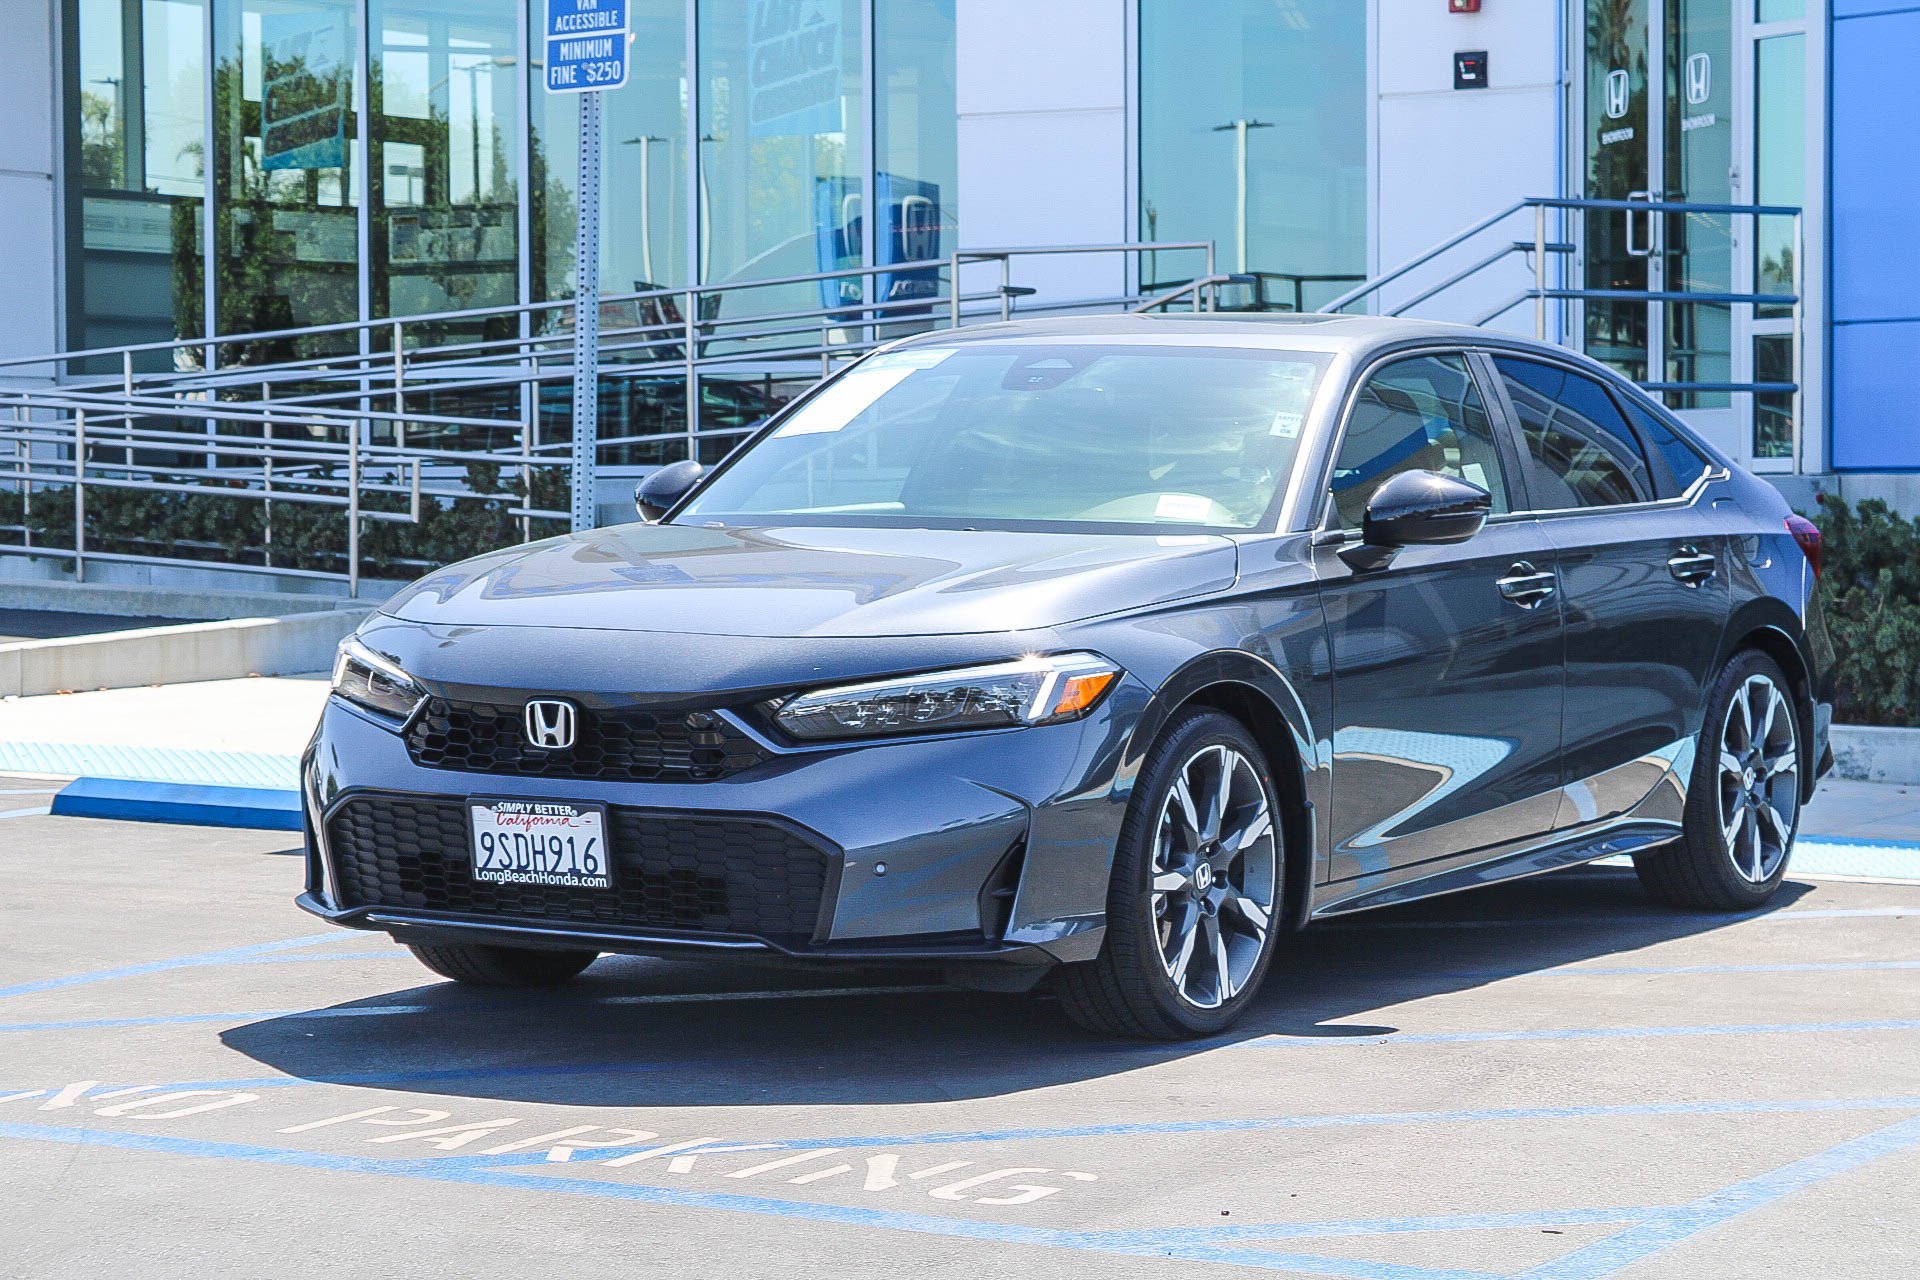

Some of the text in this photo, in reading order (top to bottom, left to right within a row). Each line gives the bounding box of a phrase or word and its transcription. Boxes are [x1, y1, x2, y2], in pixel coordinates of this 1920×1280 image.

[555, 10, 618, 31] ACCESSIBLE
[560, 38, 613, 61] MINIMUM
[550, 60, 621, 85] FINE $250
[497, 801, 572, 816] SIMPLY BETTER
[496, 811, 580, 832] California
[480, 831, 599, 874] 9SDH916
[474, 868, 608, 888] LongBeachHonda.com
[0, 1080, 1099, 1205] NO PARKING
